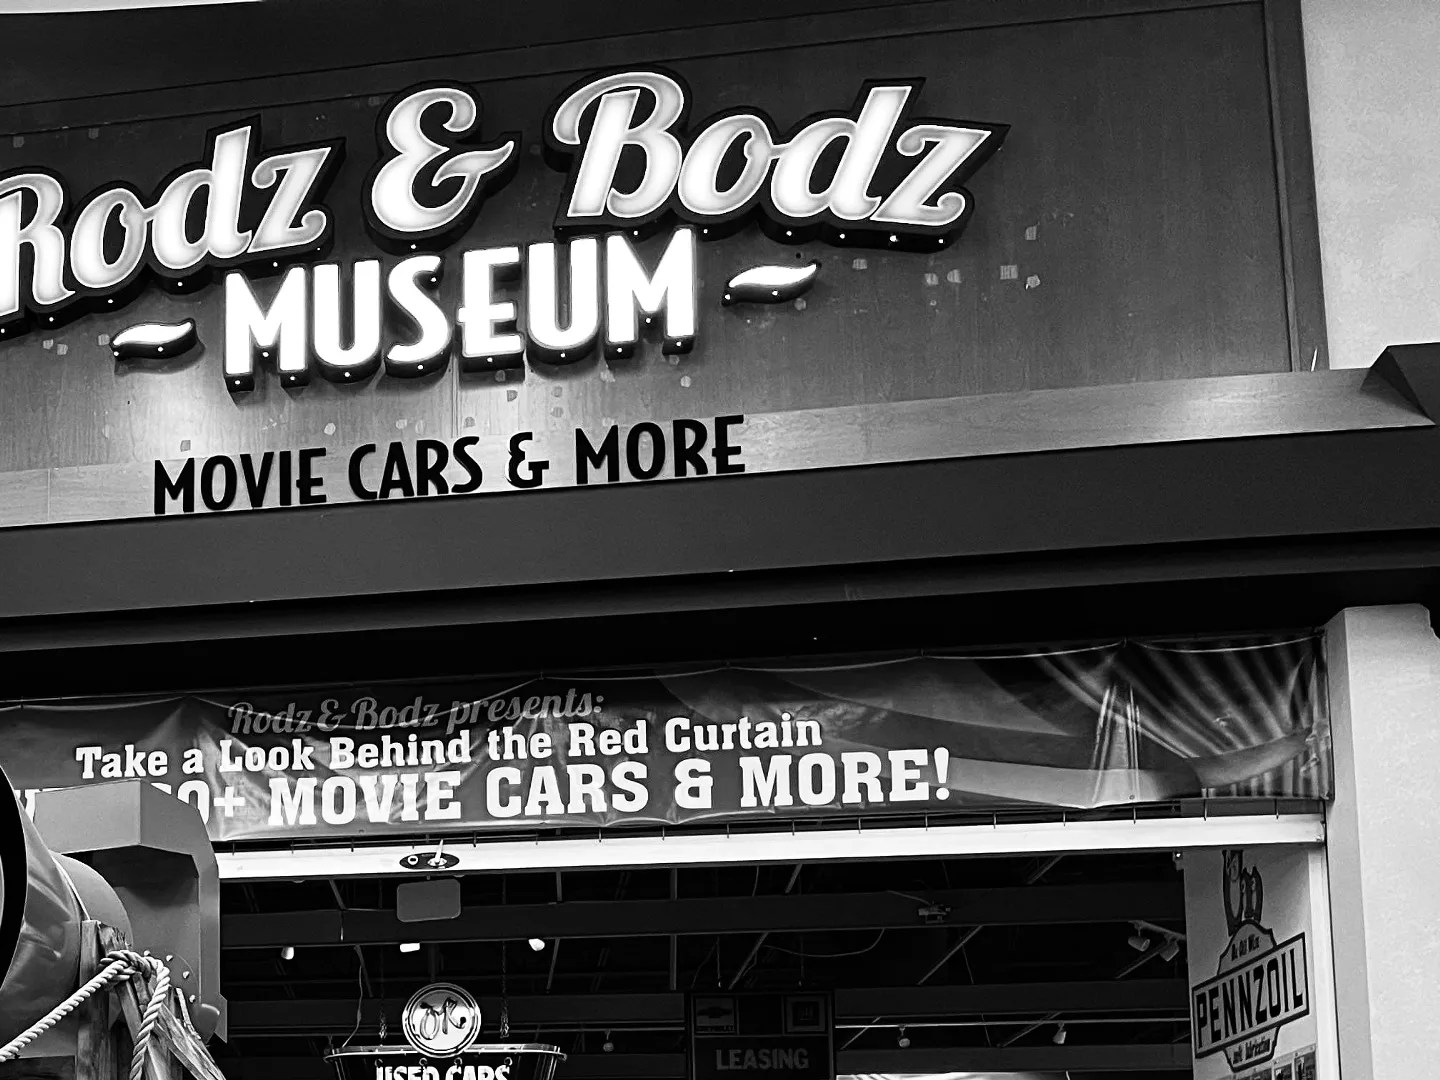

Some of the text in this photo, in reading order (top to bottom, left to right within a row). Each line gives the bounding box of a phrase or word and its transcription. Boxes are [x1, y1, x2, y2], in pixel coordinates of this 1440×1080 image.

[370, 86, 515, 233] &
[551, 71, 993, 226] Bodz
[223, 227, 696, 377] MUSEUM
[154, 414, 746, 515] MOVIE CARS & MORE
[75, 712, 823, 780] Take a Look Behind the Red Curtain
[228, 687, 605, 735] Rodz & Bodz presents:
[151, 747, 952, 830] 0+ MOVIE CARS & MORE!
[419, 996, 467, 1041] OK
[1195, 948, 1304, 1050] PENNZOIL
[715, 1047, 810, 1071] LEASING
